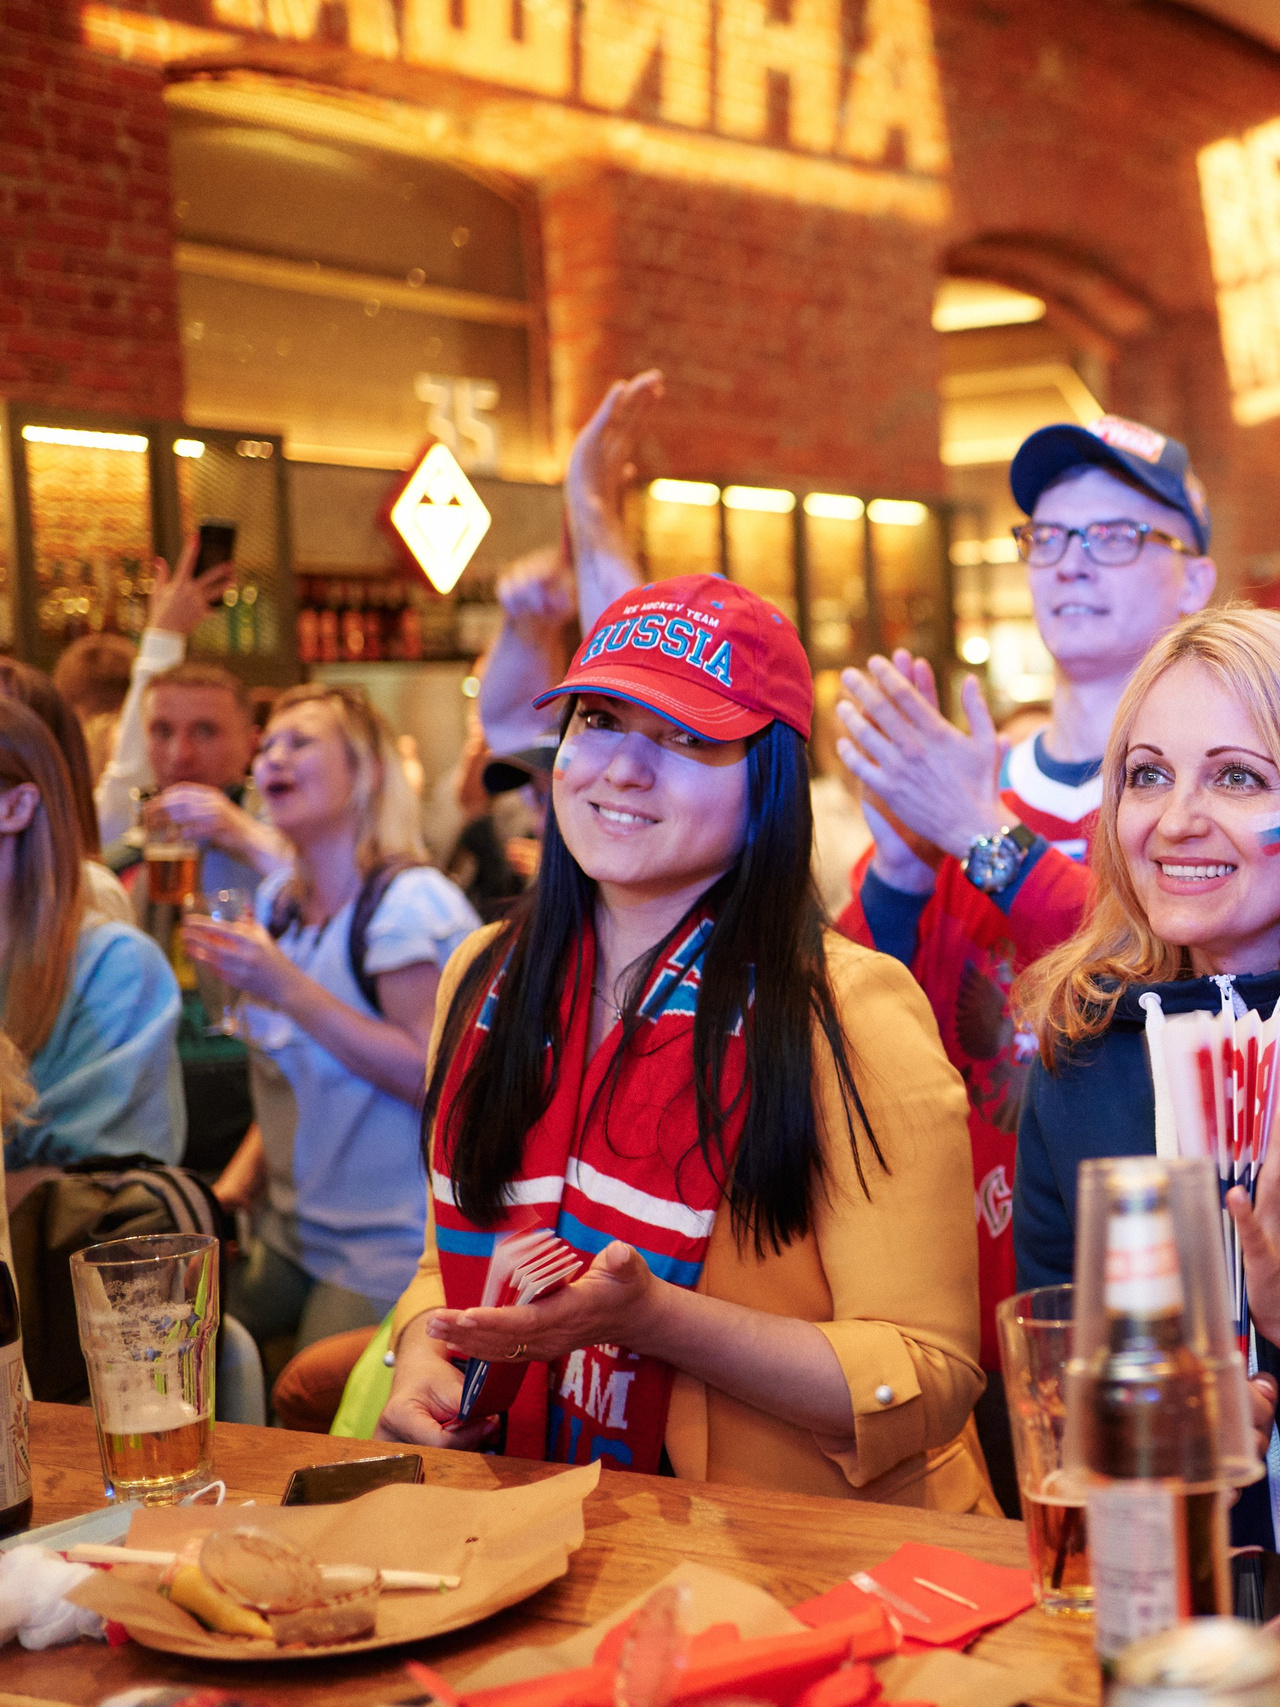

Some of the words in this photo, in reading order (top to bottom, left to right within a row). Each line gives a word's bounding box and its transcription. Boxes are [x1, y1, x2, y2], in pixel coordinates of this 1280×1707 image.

[623, 604, 640, 615] ICE
[640, 601, 685, 612] HOCKEY
[687, 608, 720, 628] TEAM
[580, 614, 733, 688] RUSSIA
